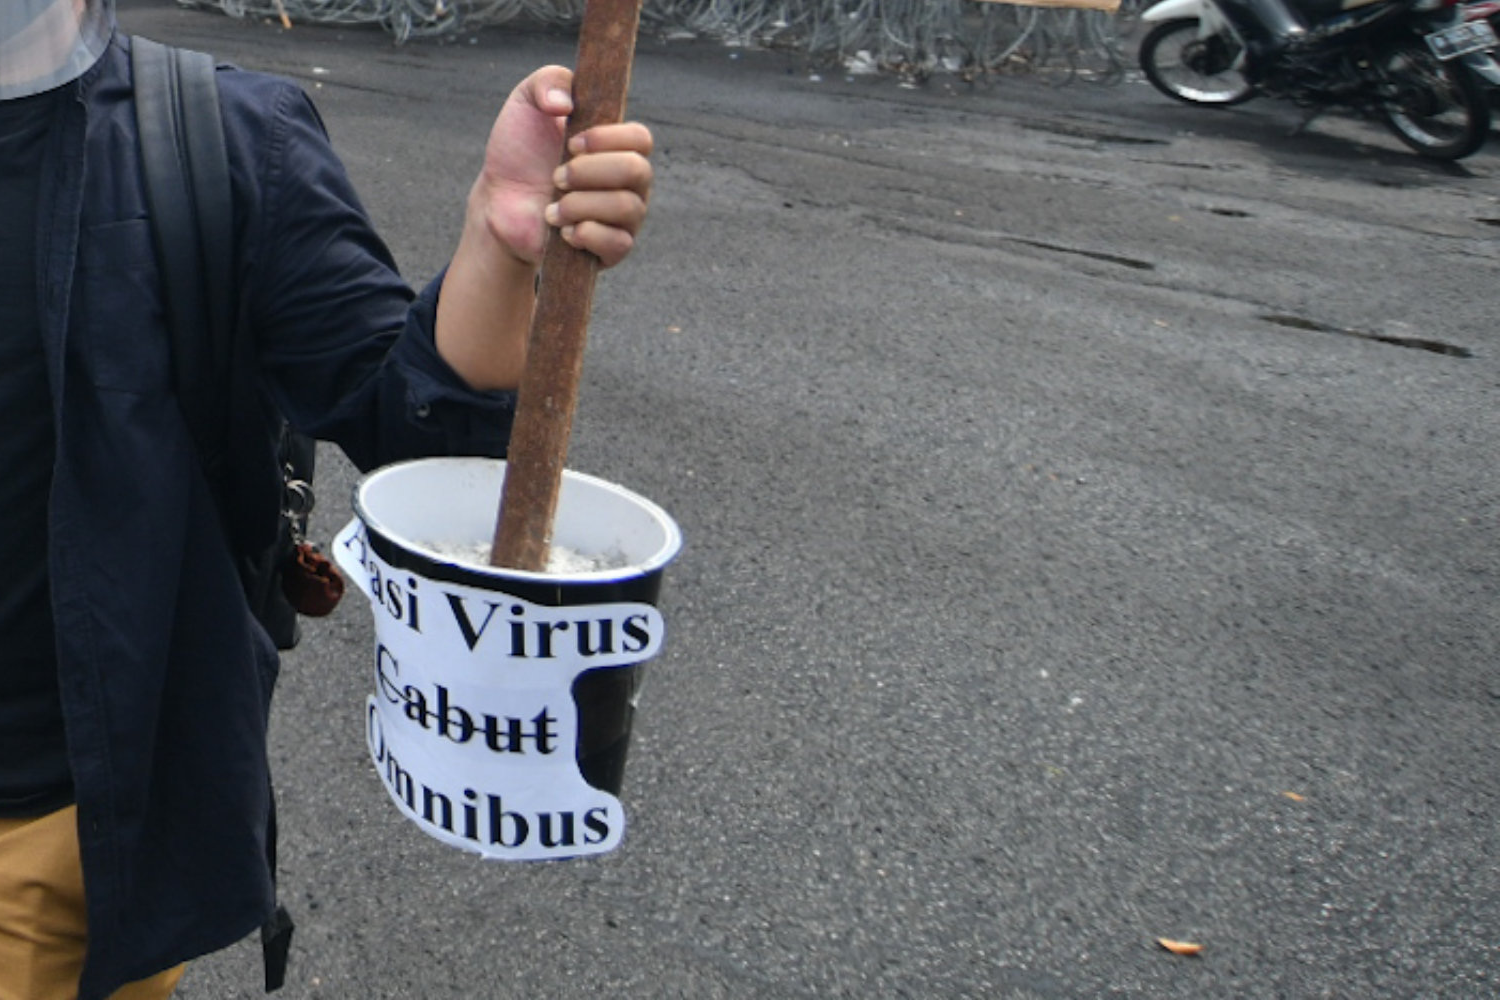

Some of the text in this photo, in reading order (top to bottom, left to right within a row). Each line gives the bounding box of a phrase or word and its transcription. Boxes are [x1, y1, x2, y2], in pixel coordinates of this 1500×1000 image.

[443, 591, 650, 659] Virus
[376, 643, 558, 756] Cabut
[368, 703, 611, 849] Omnibus
